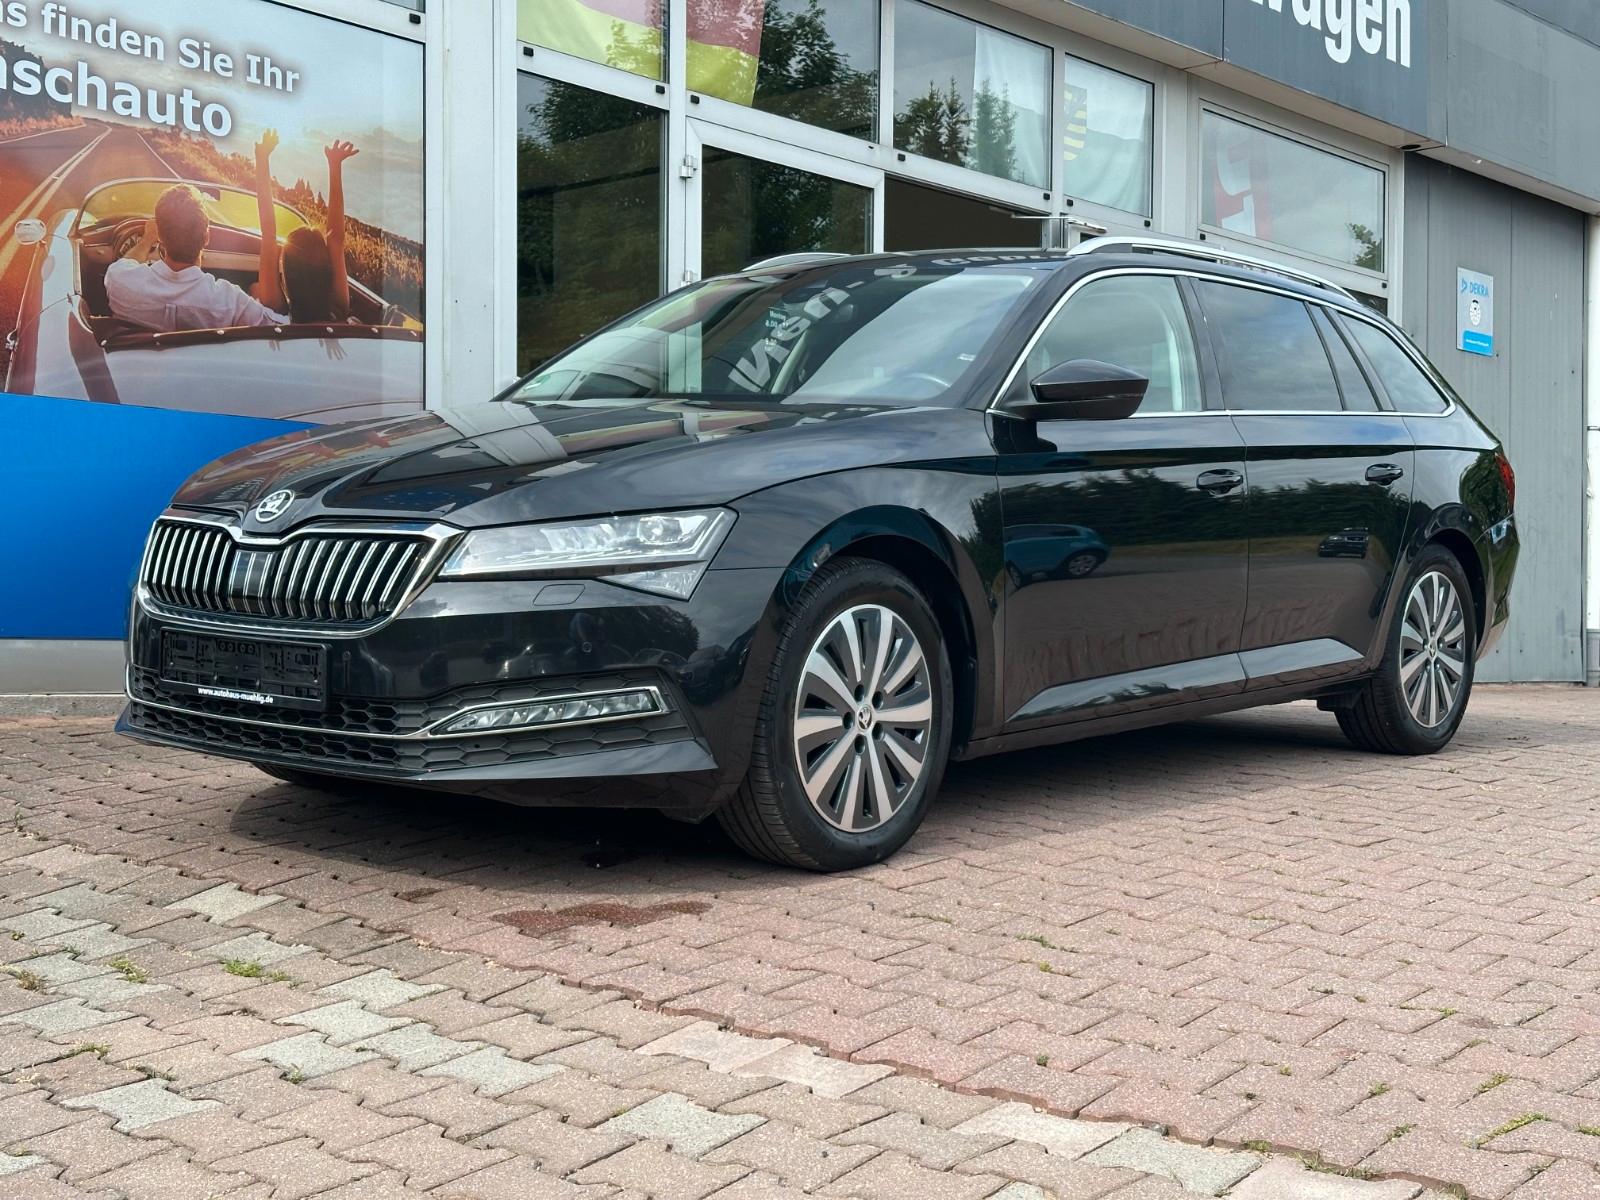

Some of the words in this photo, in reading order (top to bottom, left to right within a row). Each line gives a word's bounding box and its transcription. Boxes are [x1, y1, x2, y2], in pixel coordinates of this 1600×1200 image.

[0, 0, 27, 27] s
[41, 2, 164, 61] finden
[179, 38, 233, 77] Sie
[246, 53, 300, 93] Ihr
[0, 55, 232, 137] schauto
[1469, 282, 1489, 297] DEKRA
[197, 687, 274, 705] www.autohaus-muehlig.de
